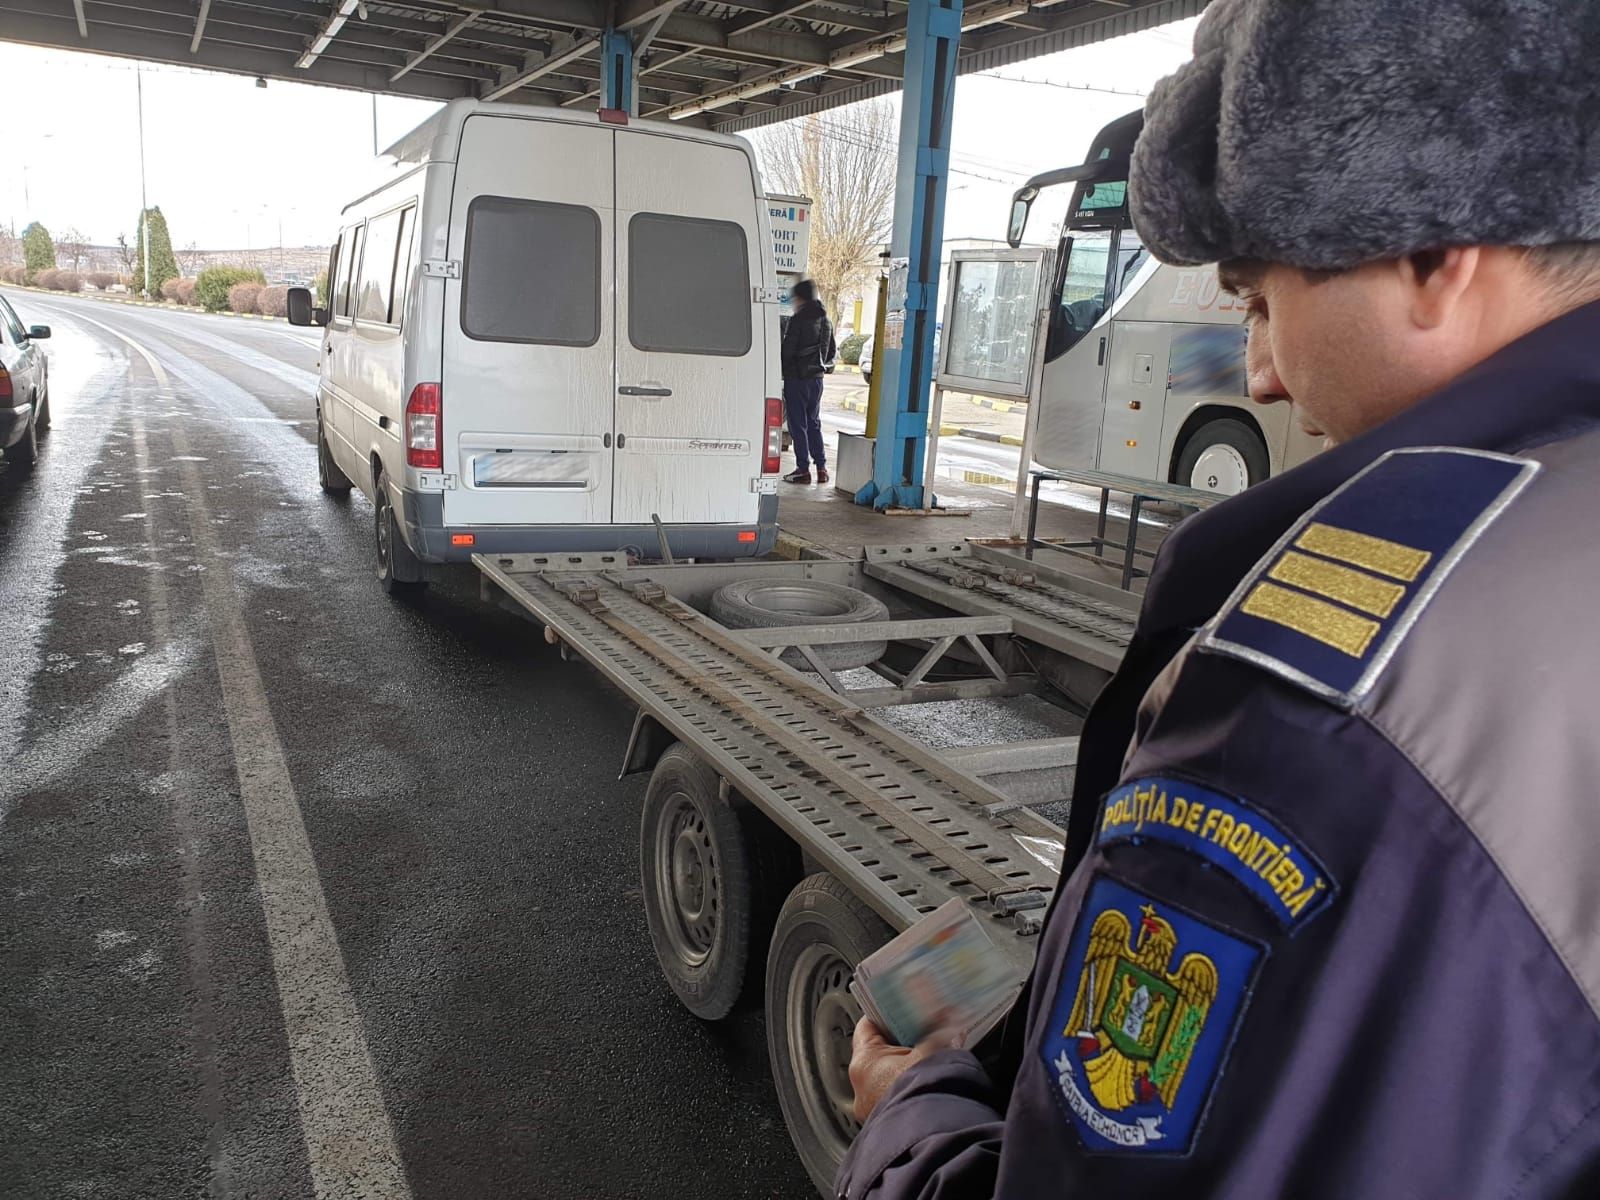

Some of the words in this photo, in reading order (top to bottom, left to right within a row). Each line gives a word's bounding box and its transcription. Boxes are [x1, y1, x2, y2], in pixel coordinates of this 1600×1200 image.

[769, 207, 787, 219] ERĂ
[772, 229, 798, 241] ORT
[1167, 797, 1205, 833] DE
